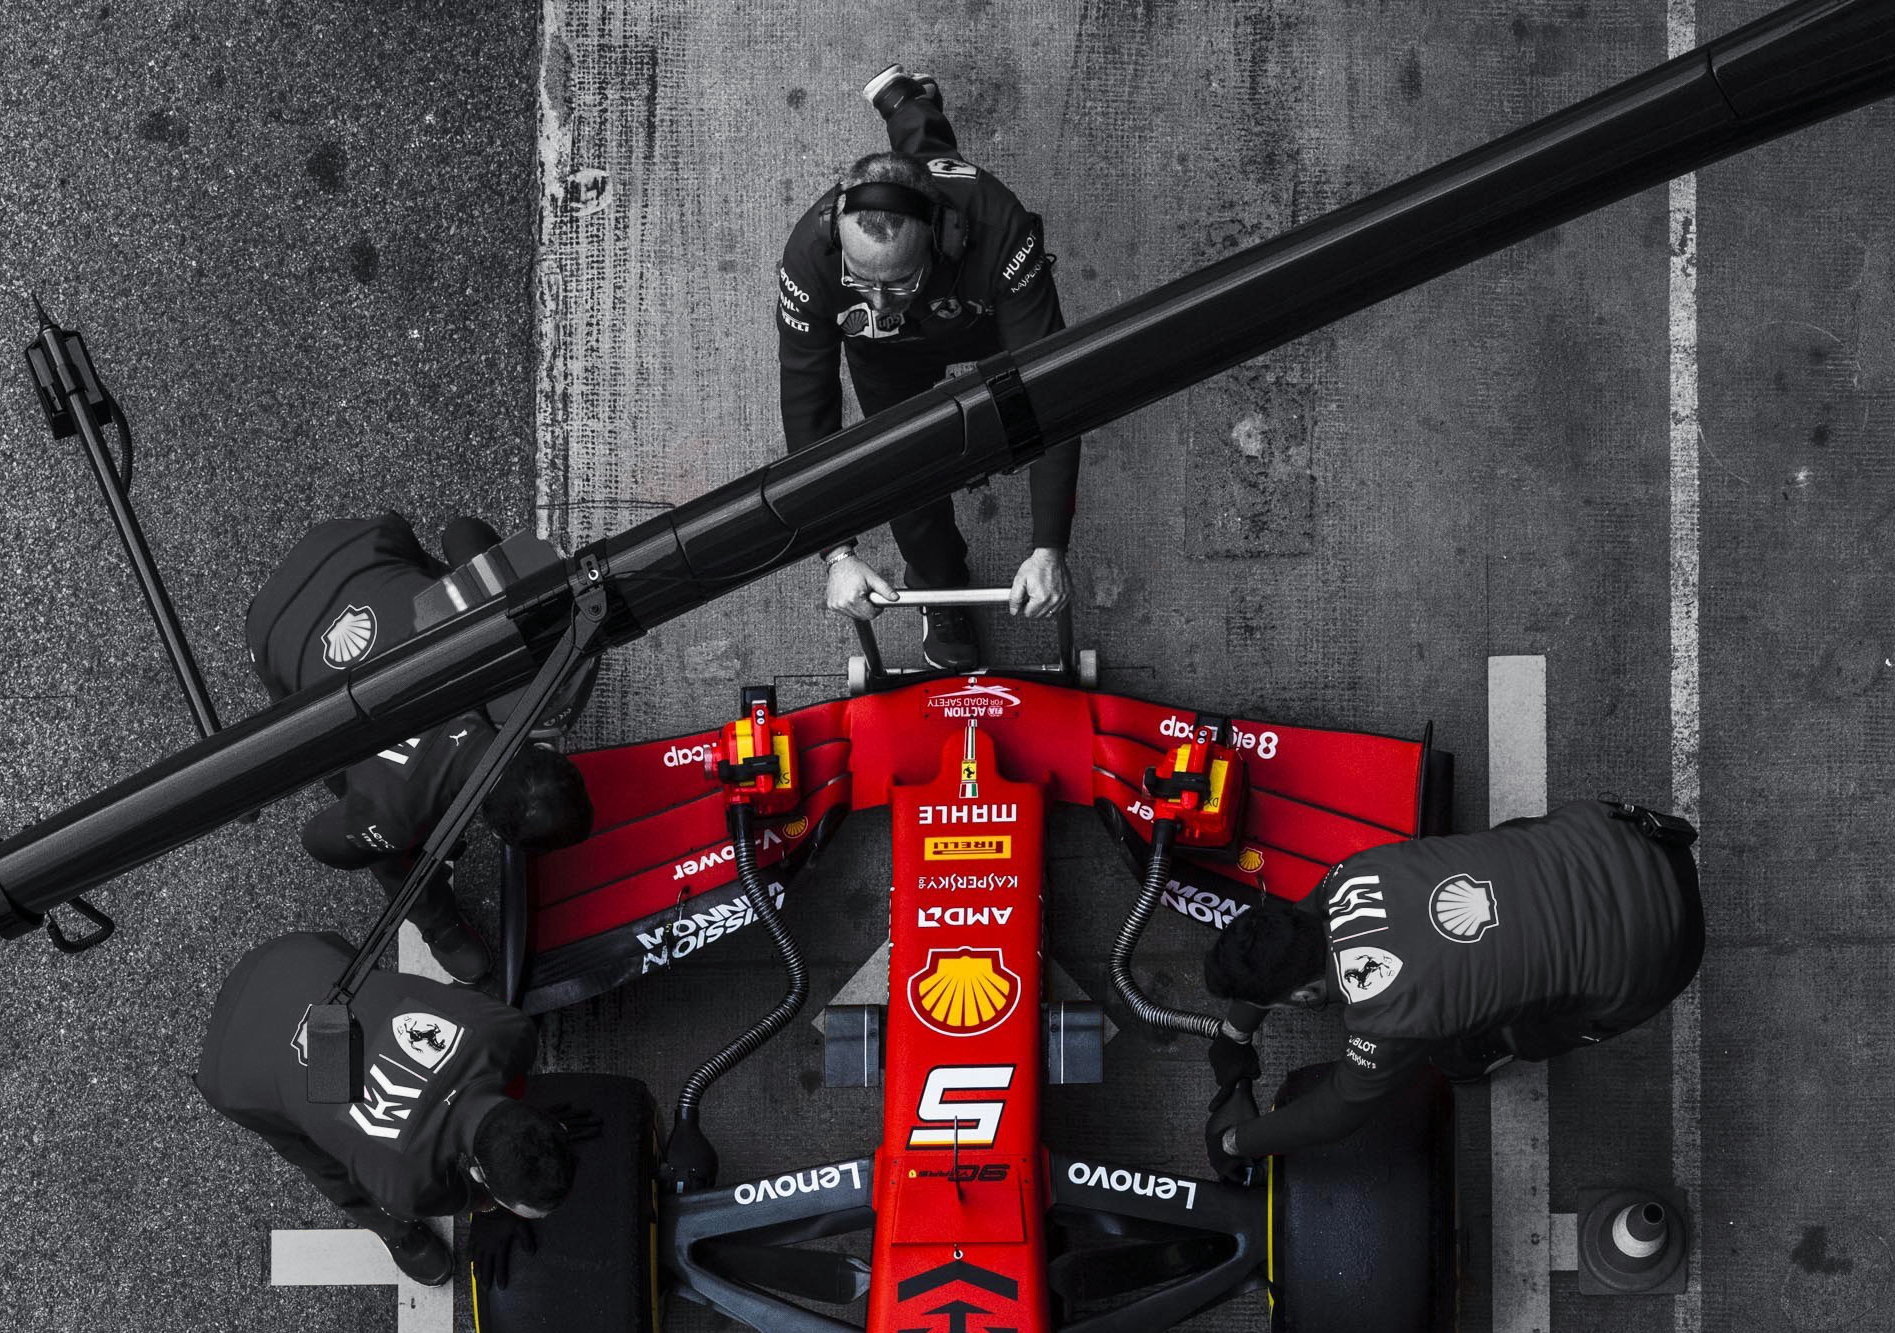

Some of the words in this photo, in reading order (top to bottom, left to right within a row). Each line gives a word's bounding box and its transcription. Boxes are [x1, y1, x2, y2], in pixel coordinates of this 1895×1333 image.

[927, 698, 962, 707] SAFETY
[963, 697, 989, 706] ROAD
[944, 706, 986, 718] ACTION
[918, 803, 1018, 825] MAHLE
[932, 840, 1004, 856] PIRELLI
[926, 873, 1018, 892] KASPERSKY
[943, 907, 1014, 927] AMD
[905, 1063, 1018, 1151] 5
[734, 1162, 862, 1205] Lenovo
[1067, 1162, 1198, 1210] Lenovo
